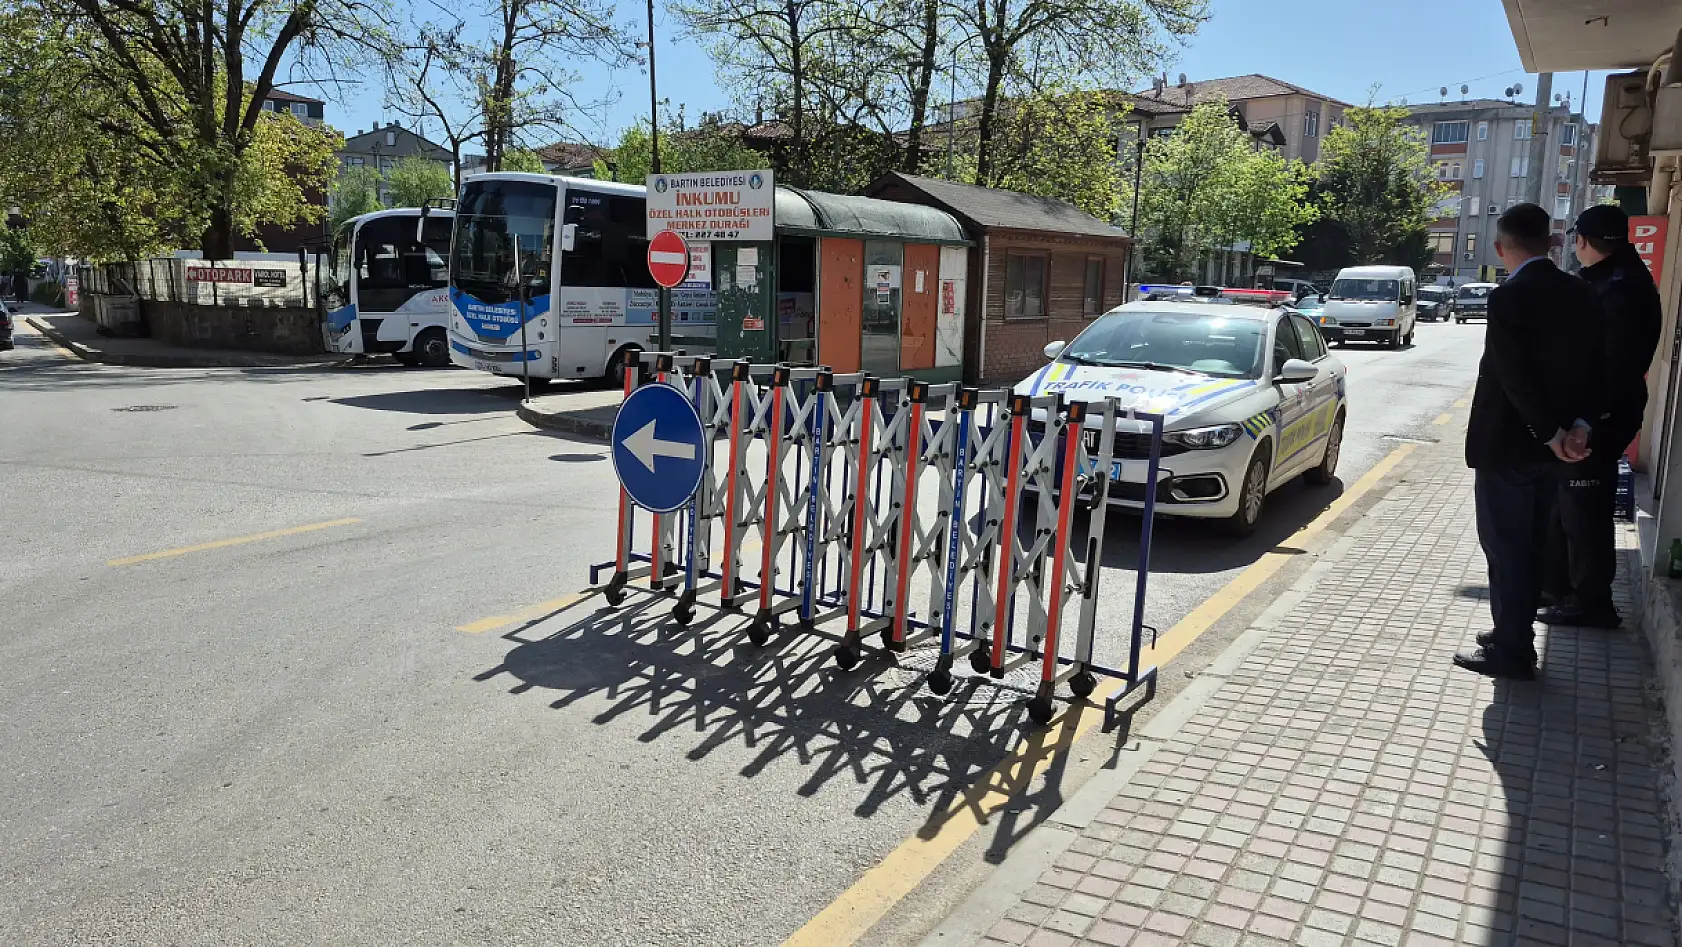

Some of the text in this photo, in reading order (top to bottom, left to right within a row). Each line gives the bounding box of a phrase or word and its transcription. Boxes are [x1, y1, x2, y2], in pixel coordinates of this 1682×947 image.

[670, 175, 746, 189] BARTIN BELEDİYESİ
[676, 190, 741, 207] İNKUMU
[649, 207, 674, 219] ÖZEL
[676, 209, 702, 218] HALK
[667, 220, 708, 230] MERKEZ
[728, 231, 740, 239] 47
[198, 270, 251, 282] OTOPARK
[812, 427, 821, 483] BARTIN
[955, 448, 966, 508] BARTIN
